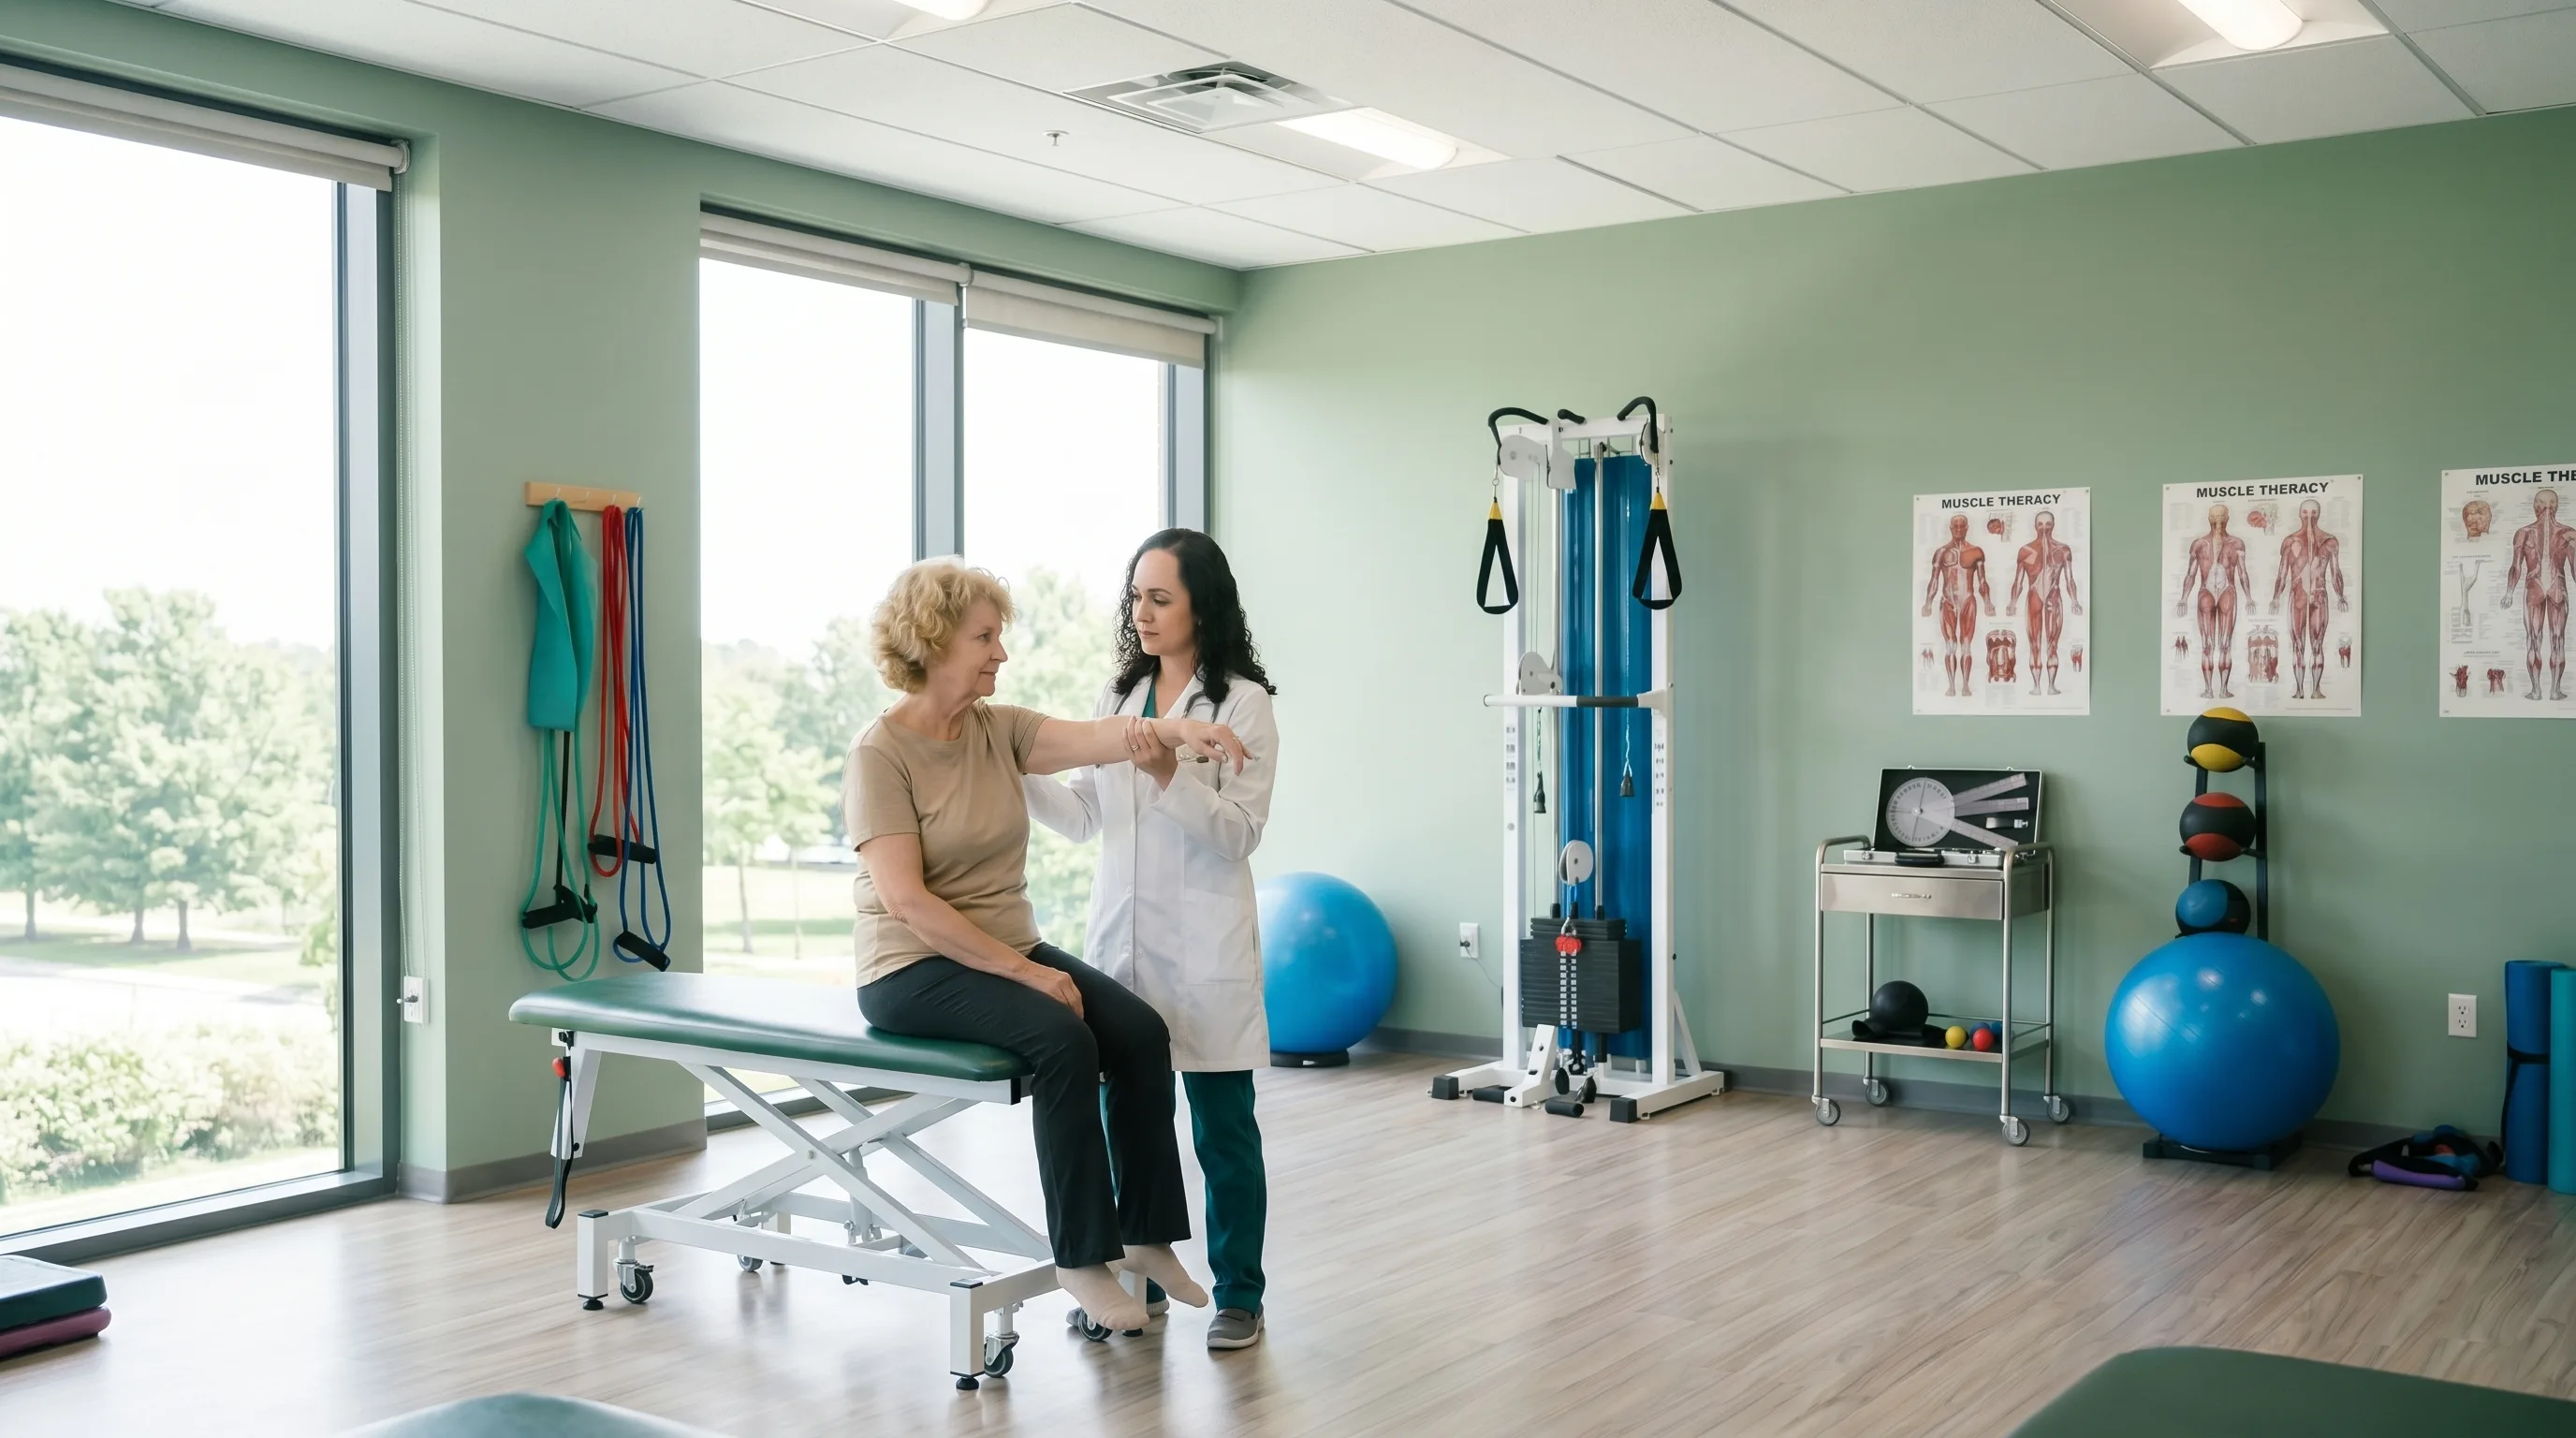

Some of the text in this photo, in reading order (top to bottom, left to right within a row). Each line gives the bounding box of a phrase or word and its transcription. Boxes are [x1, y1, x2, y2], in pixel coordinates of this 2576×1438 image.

[2475, 471, 2542, 486] MUSCLE
[2196, 481, 2329, 498] MUSCLE THERACY
[1941, 493, 2061, 509] MUSCLE THERACY
